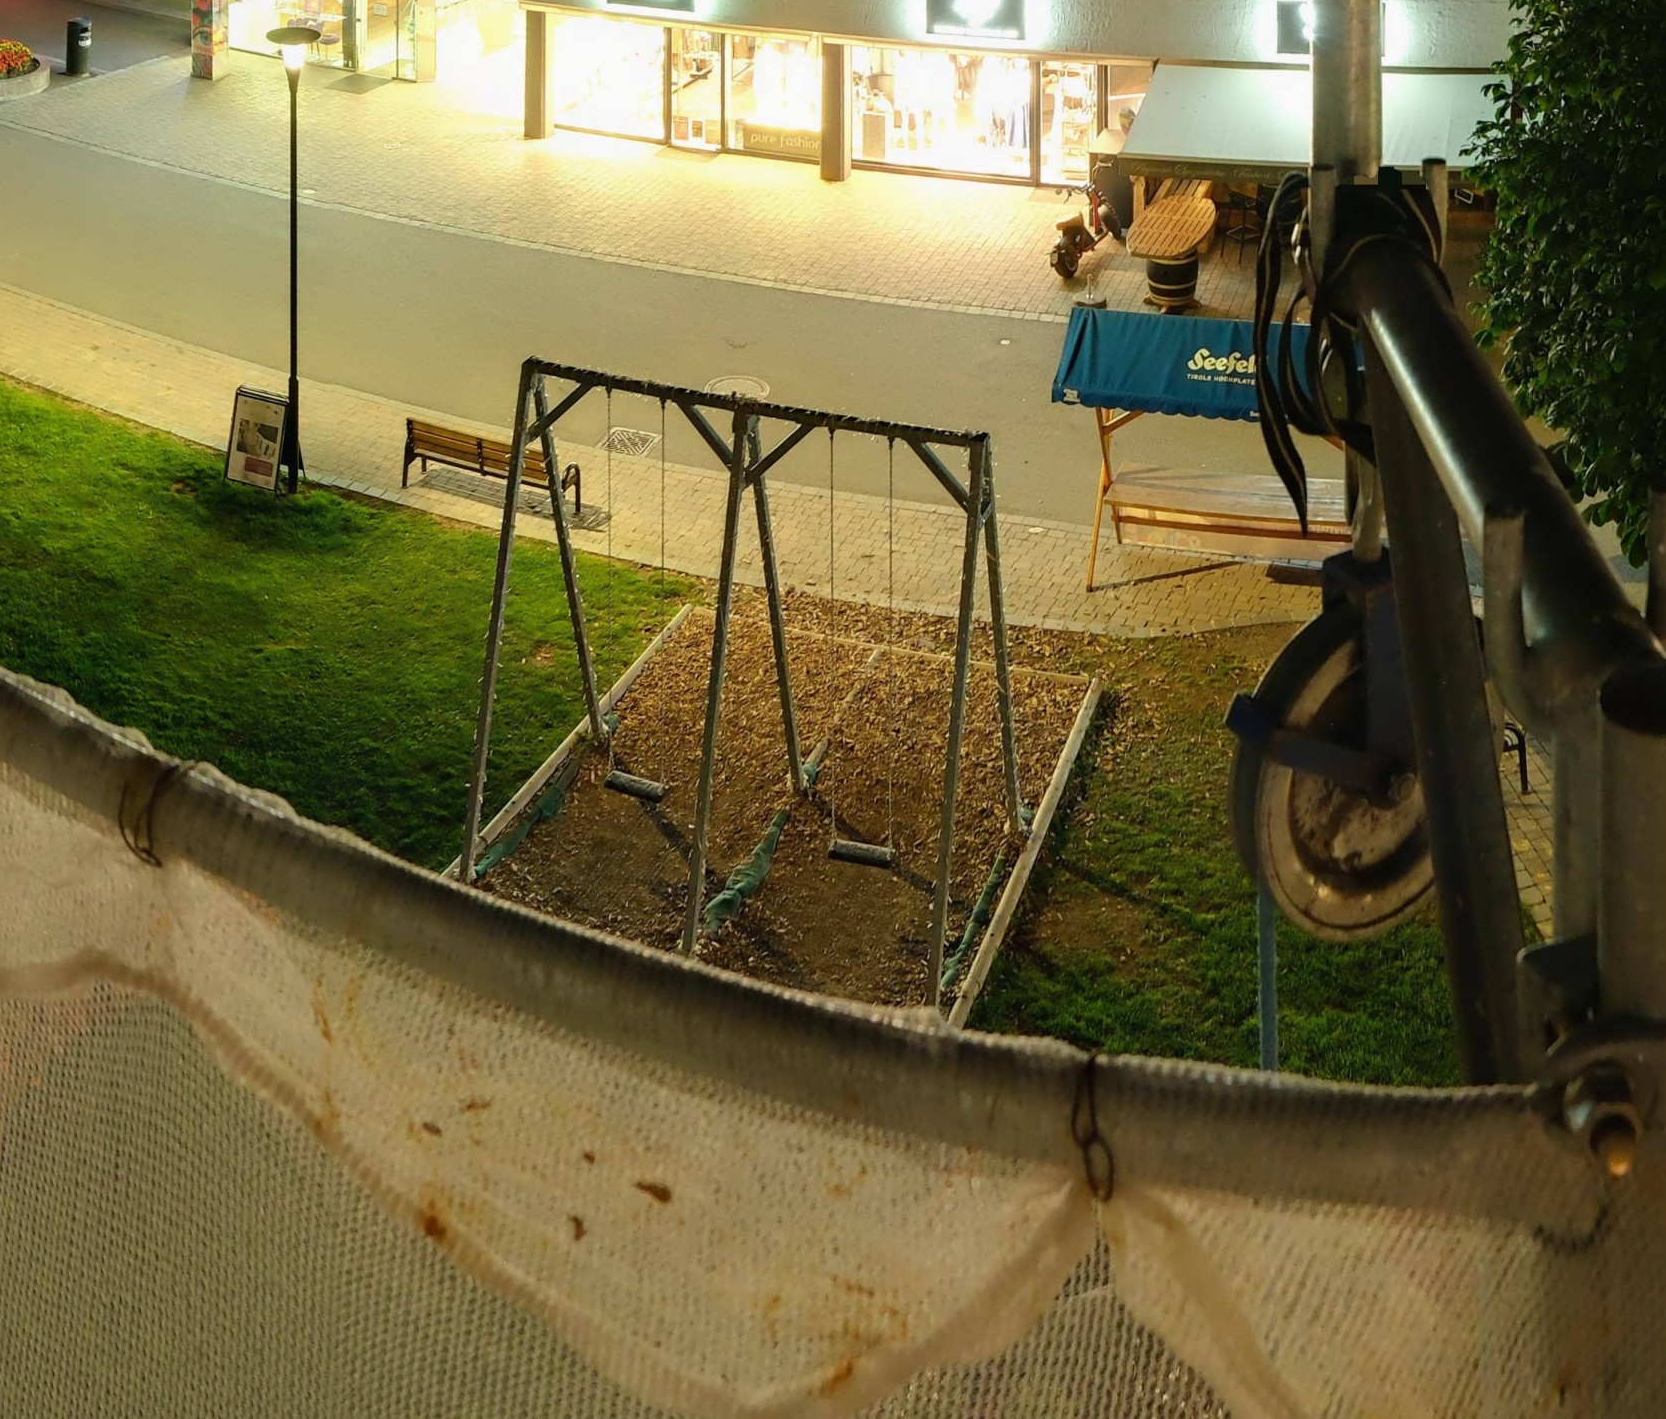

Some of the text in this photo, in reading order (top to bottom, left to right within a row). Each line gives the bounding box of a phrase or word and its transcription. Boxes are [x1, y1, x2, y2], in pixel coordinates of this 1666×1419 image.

[751, 133, 777, 144] pure
[1187, 347, 1256, 374] Seefel
[1186, 373, 1256, 386] TIROLS HOCHPLATE
